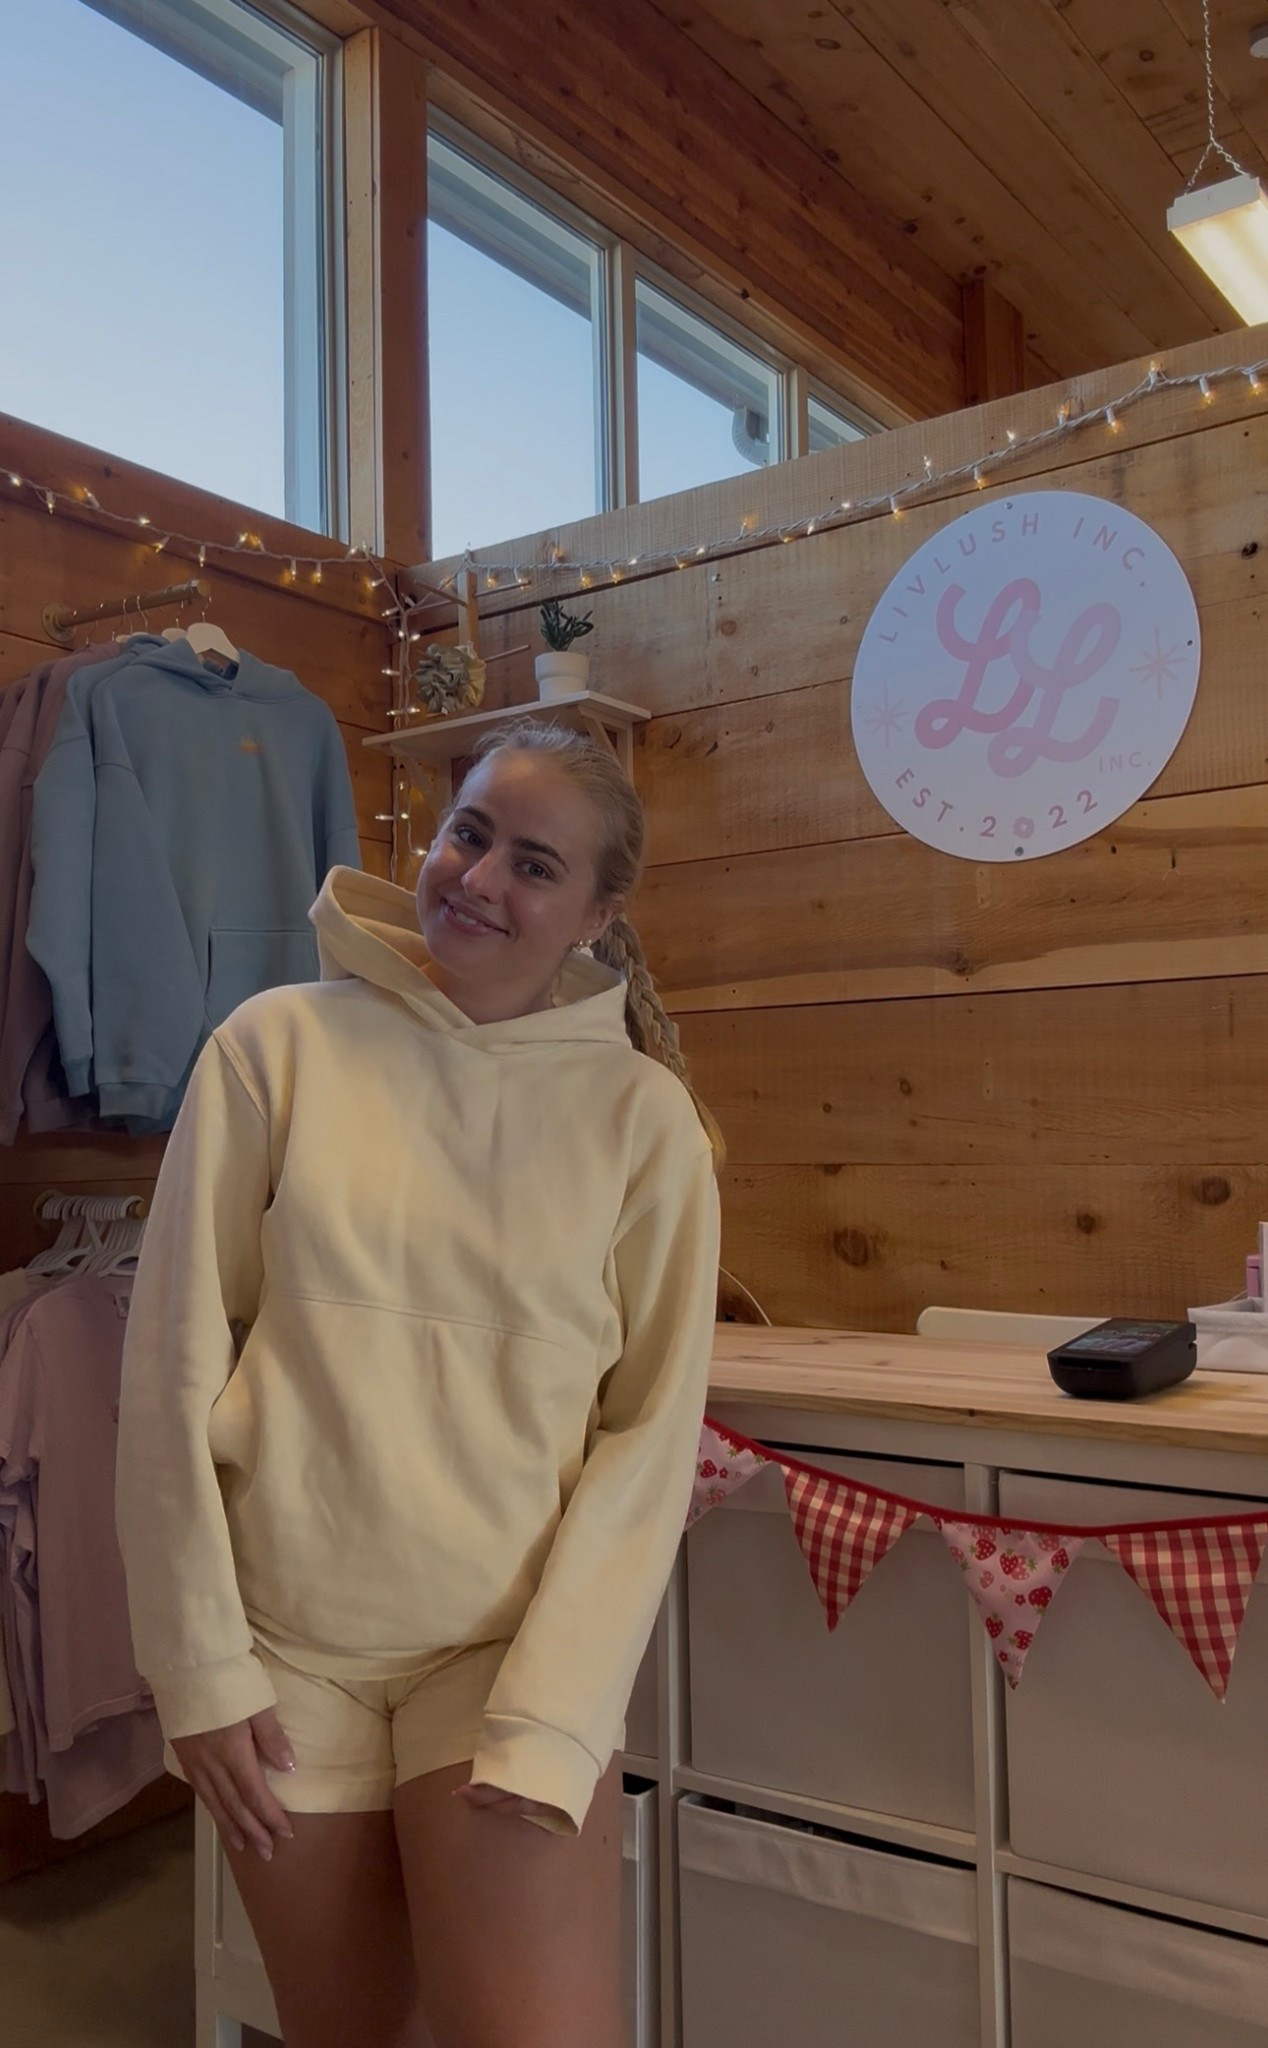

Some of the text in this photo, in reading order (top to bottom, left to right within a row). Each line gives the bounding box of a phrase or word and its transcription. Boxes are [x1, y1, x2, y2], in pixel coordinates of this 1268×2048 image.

[879, 513, 1146, 643] LIVLUSH INC.
[1100, 751, 1153, 774] INC.
[895, 768, 965, 831] EST.
